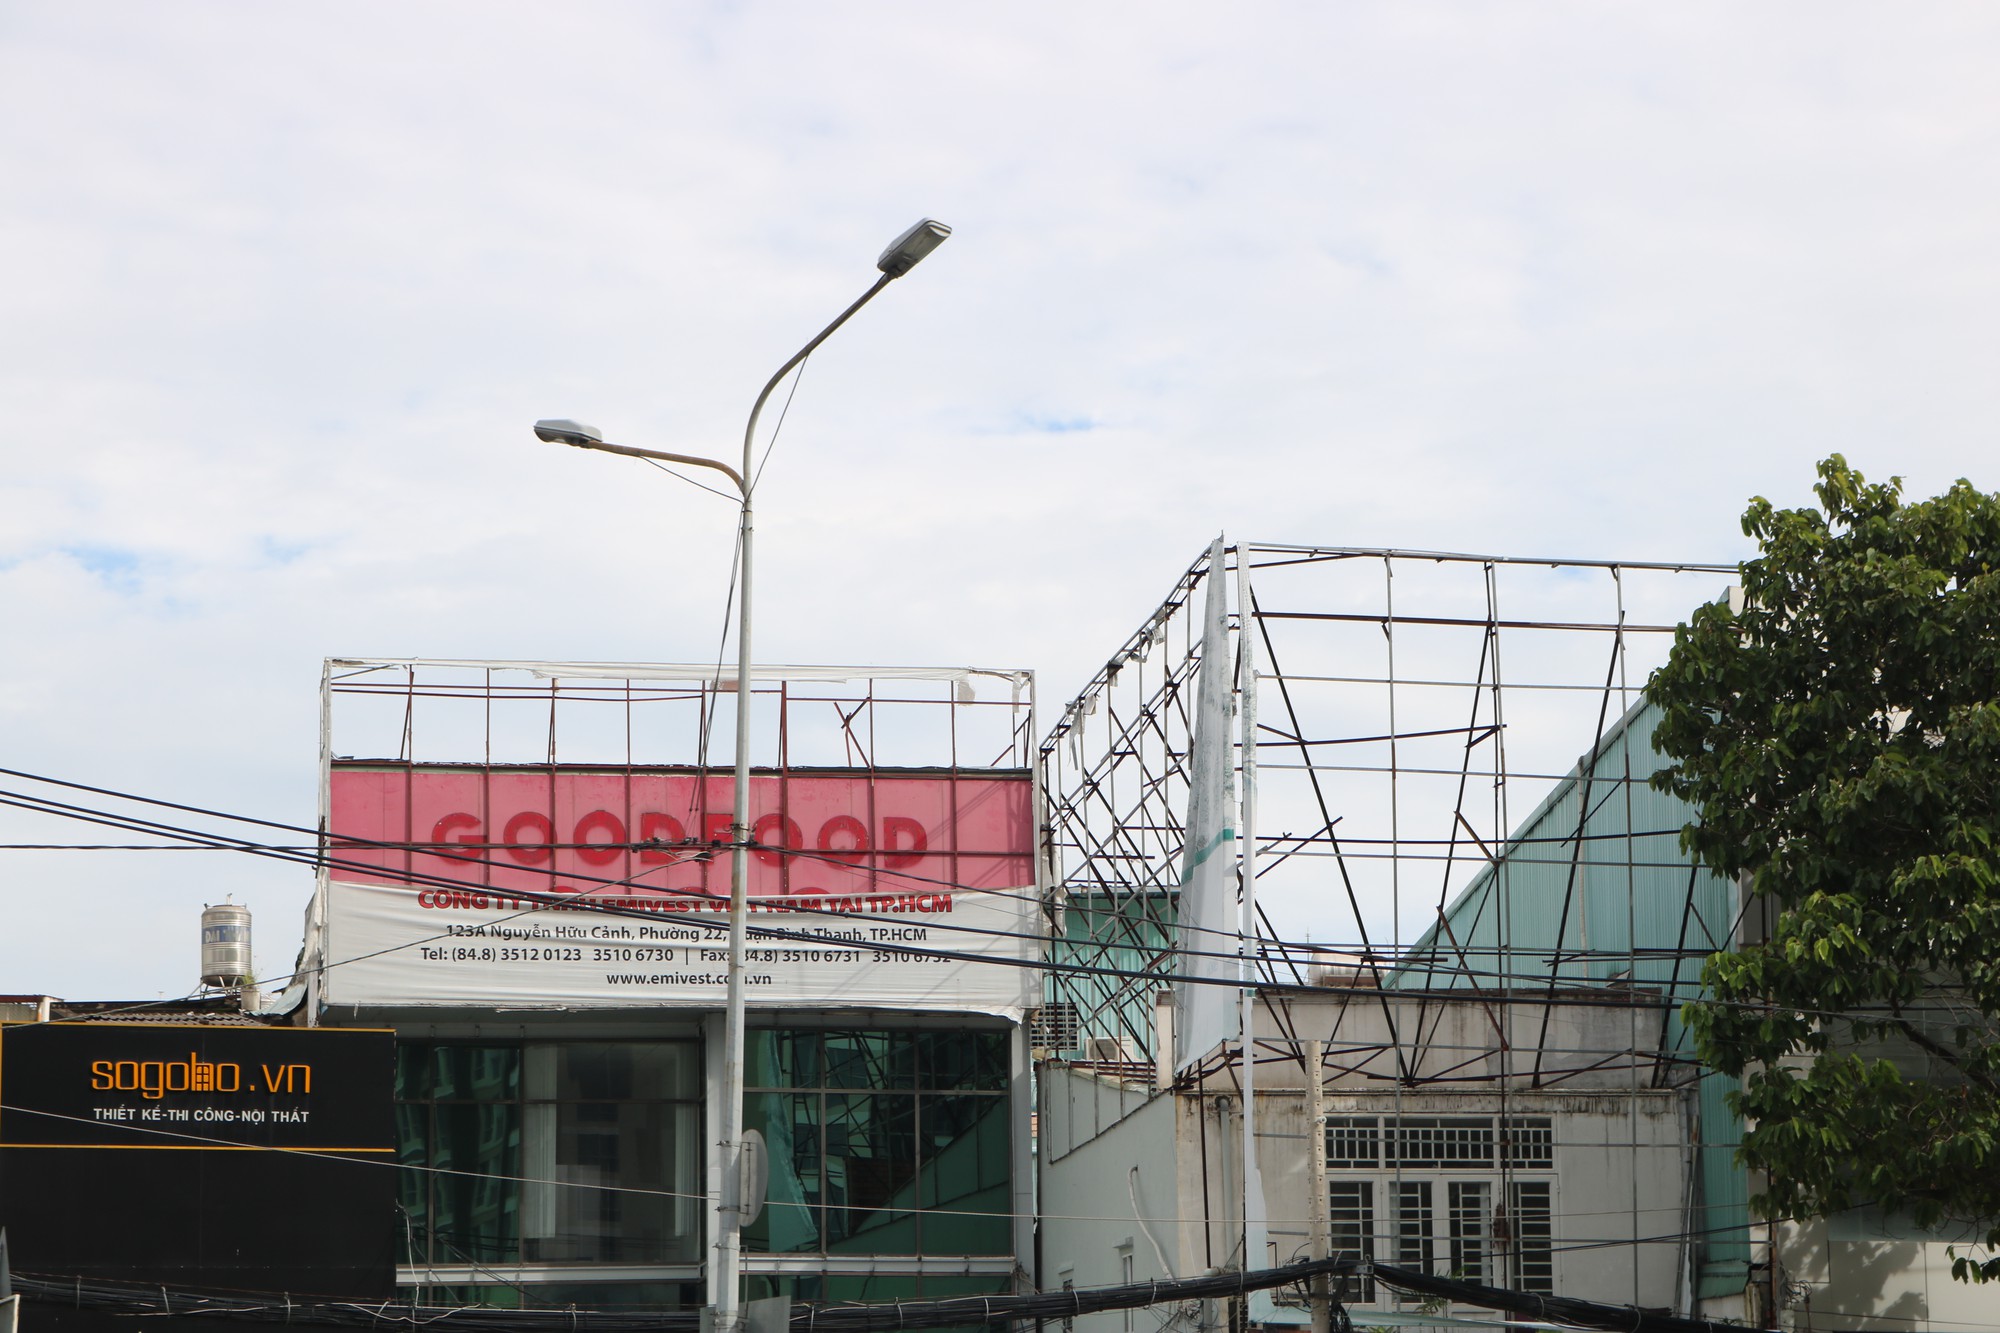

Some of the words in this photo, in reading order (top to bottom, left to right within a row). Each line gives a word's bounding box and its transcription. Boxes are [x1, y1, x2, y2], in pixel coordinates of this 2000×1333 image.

[708, 899, 759, 914] VIT
[866, 893, 953, 913] TP.HCM
[446, 925, 486, 938] 123A
[490, 923, 551, 941] Nguyễn
[556, 926, 587, 939] Hữu
[591, 926, 636, 941] Cảnh,
[640, 926, 700, 943] Phường
[704, 927, 728, 942] 22,
[869, 928, 927, 941] TP.HCM
[421, 947, 448, 961] Tel:
[452, 947, 497, 963] (84.8)
[501, 948, 540, 961] 3512
[543, 948, 582, 961] 0123
[593, 948, 632, 961] 3510
[635, 949, 674, 962] 6730
[700, 949, 730, 962] Fax:
[745, 949, 779, 964] 4.8)
[782, 950, 820, 963] 3510
[823, 950, 861, 963] 6731
[872, 950, 910, 963] 3510
[606, 971, 773, 986] www.emivest.co.vn
[93, 1103, 137, 1121] THIẾT
[271, 1106, 310, 1123] THẤT
